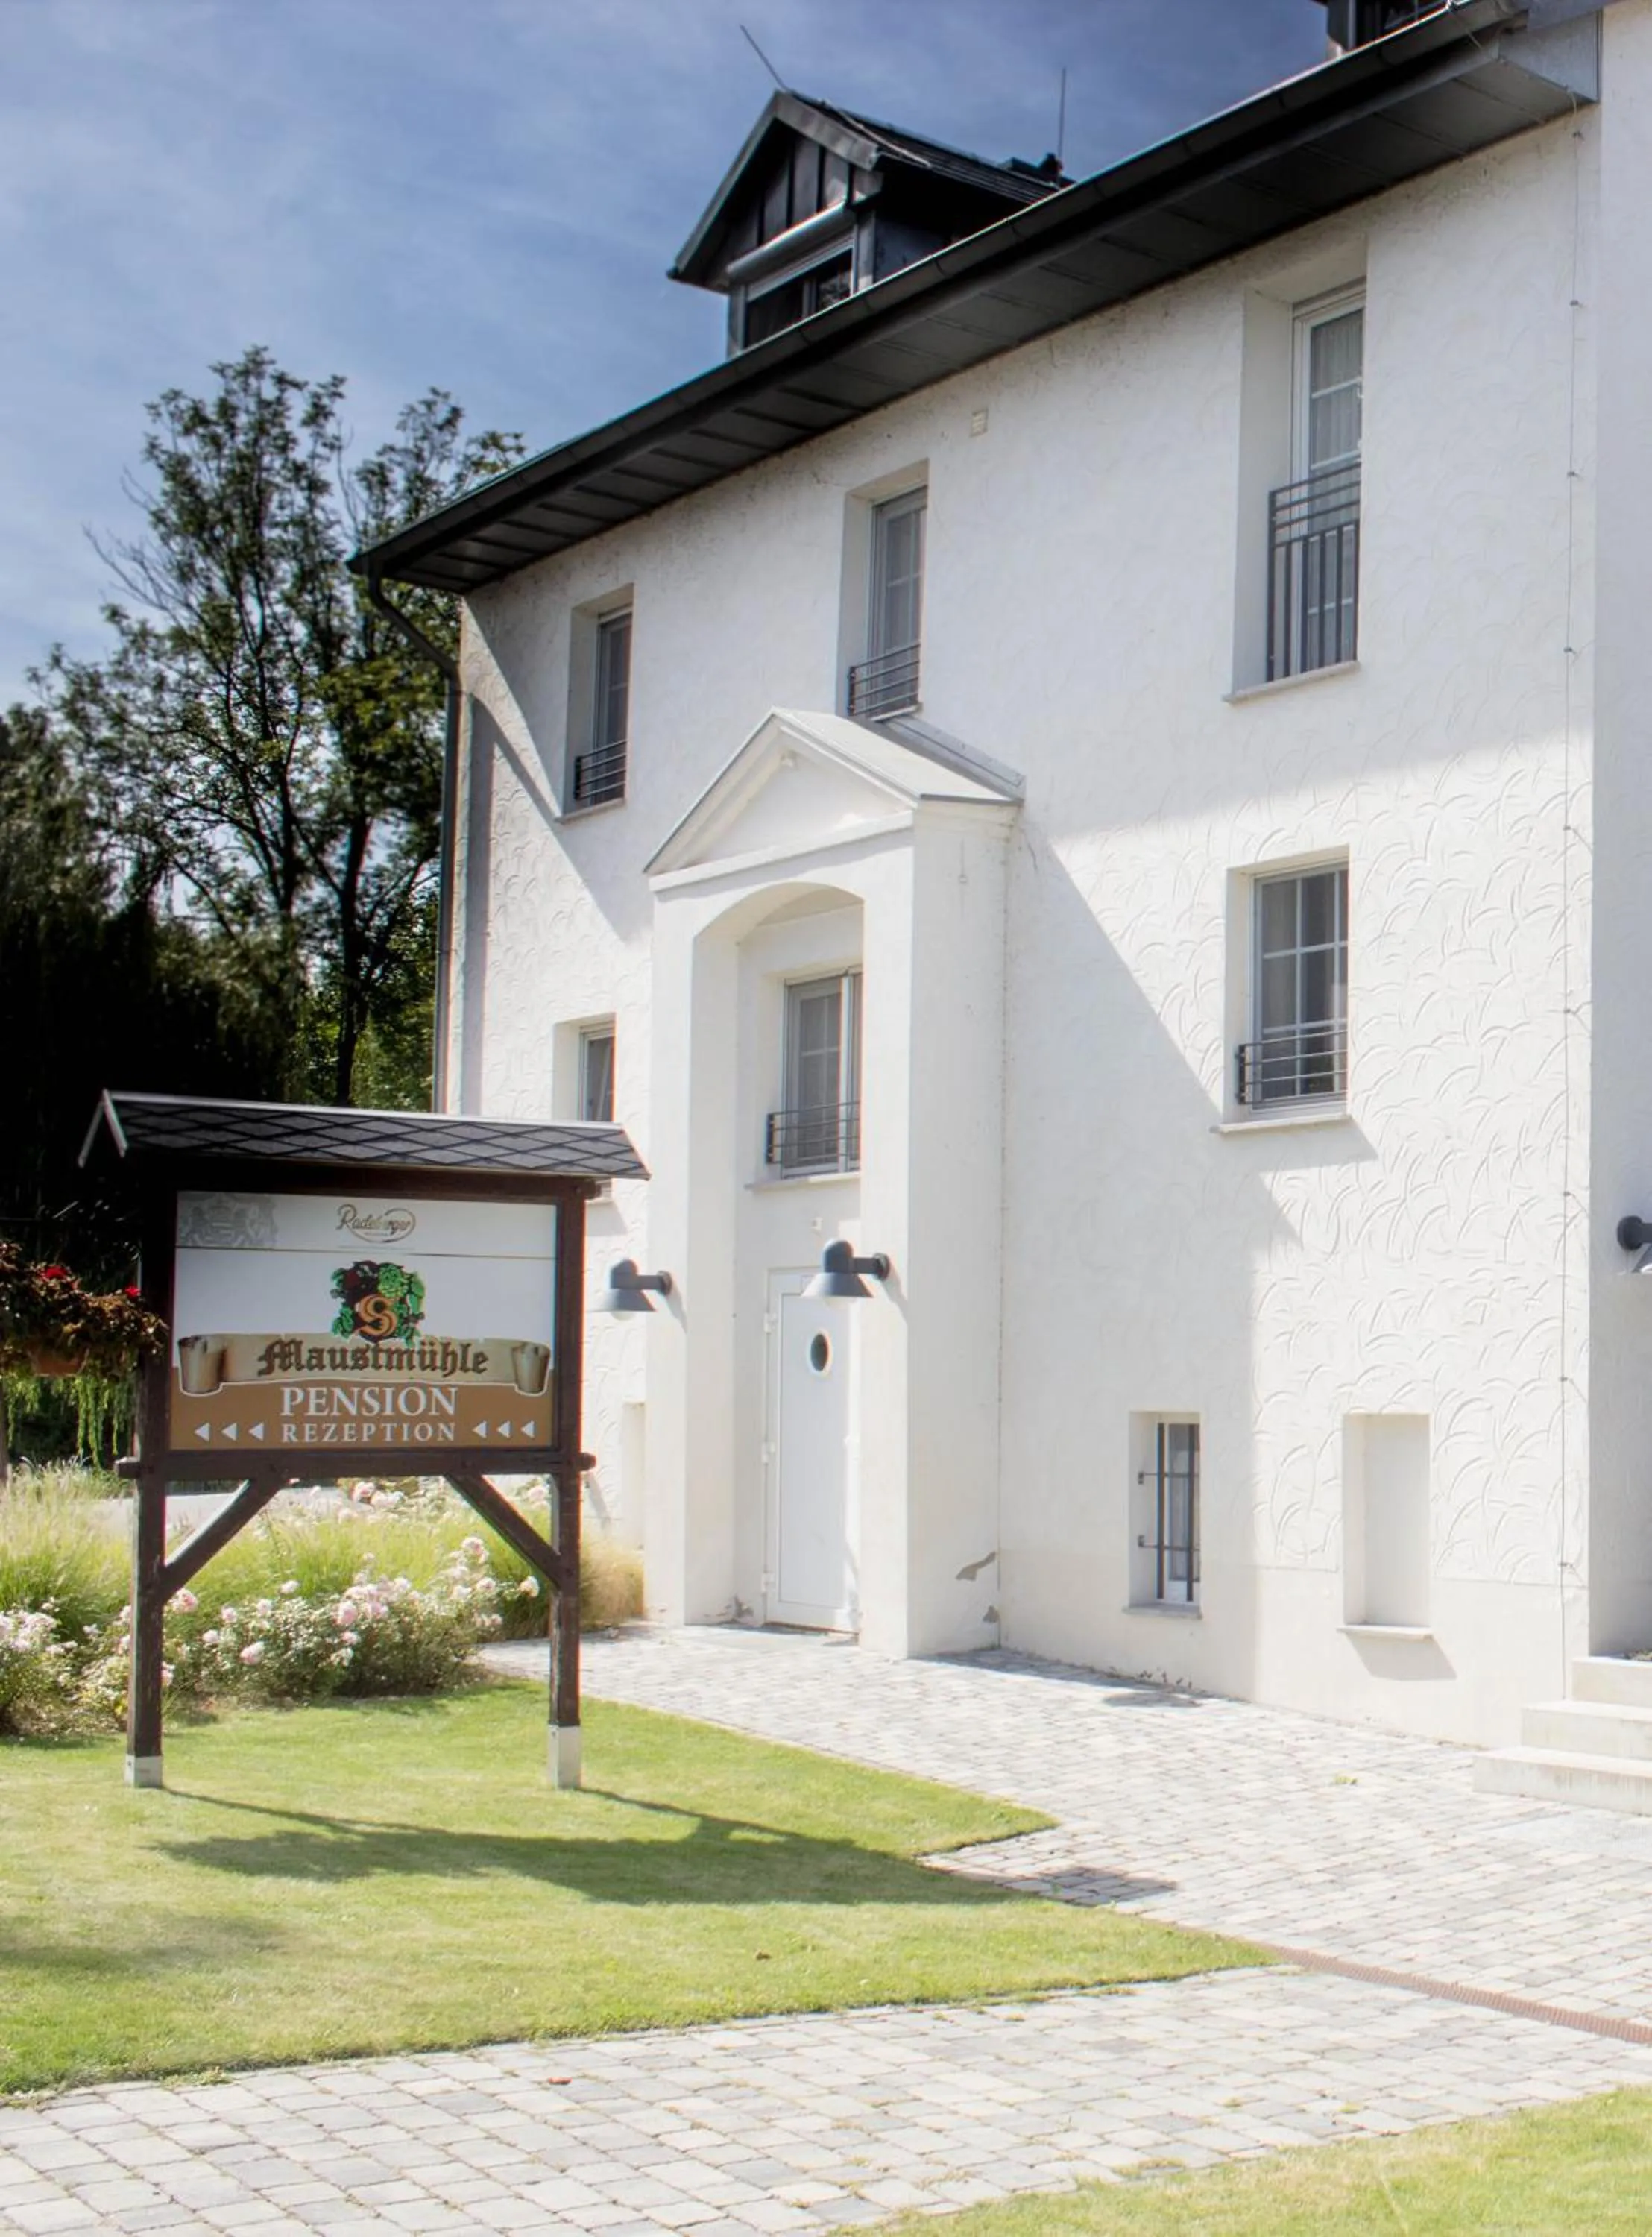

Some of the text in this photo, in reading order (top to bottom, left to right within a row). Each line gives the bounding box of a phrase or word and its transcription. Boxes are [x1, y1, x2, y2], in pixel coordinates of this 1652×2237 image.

[335, 1204, 416, 1239] Radbger
[257, 1338, 489, 1378] Maustmühle
[280, 1386, 458, 1416] PENSION
[282, 1423, 455, 1444] REZEPTION
